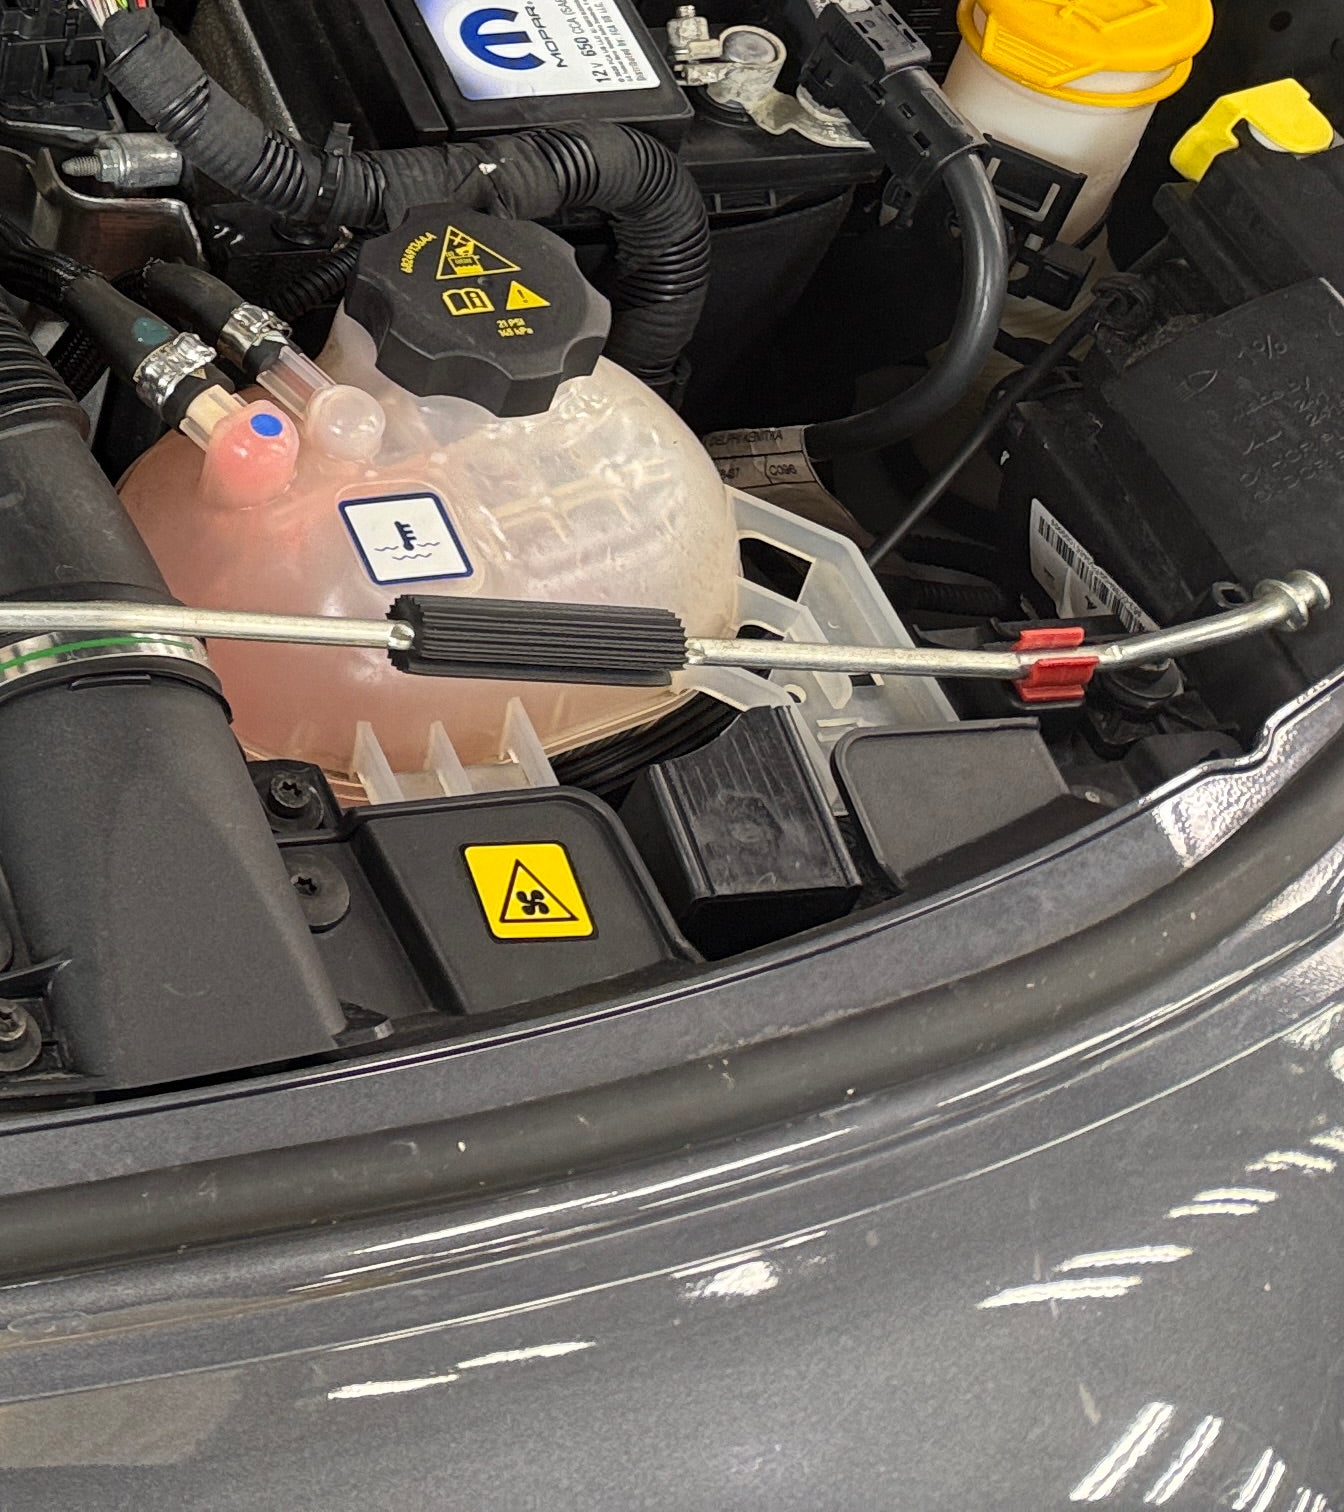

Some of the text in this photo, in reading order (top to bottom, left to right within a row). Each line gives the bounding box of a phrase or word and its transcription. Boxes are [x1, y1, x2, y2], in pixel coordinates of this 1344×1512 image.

[564, 16, 585, 34] CCA
[571, 36, 596, 57] 650
[590, 68, 612, 83] 12
